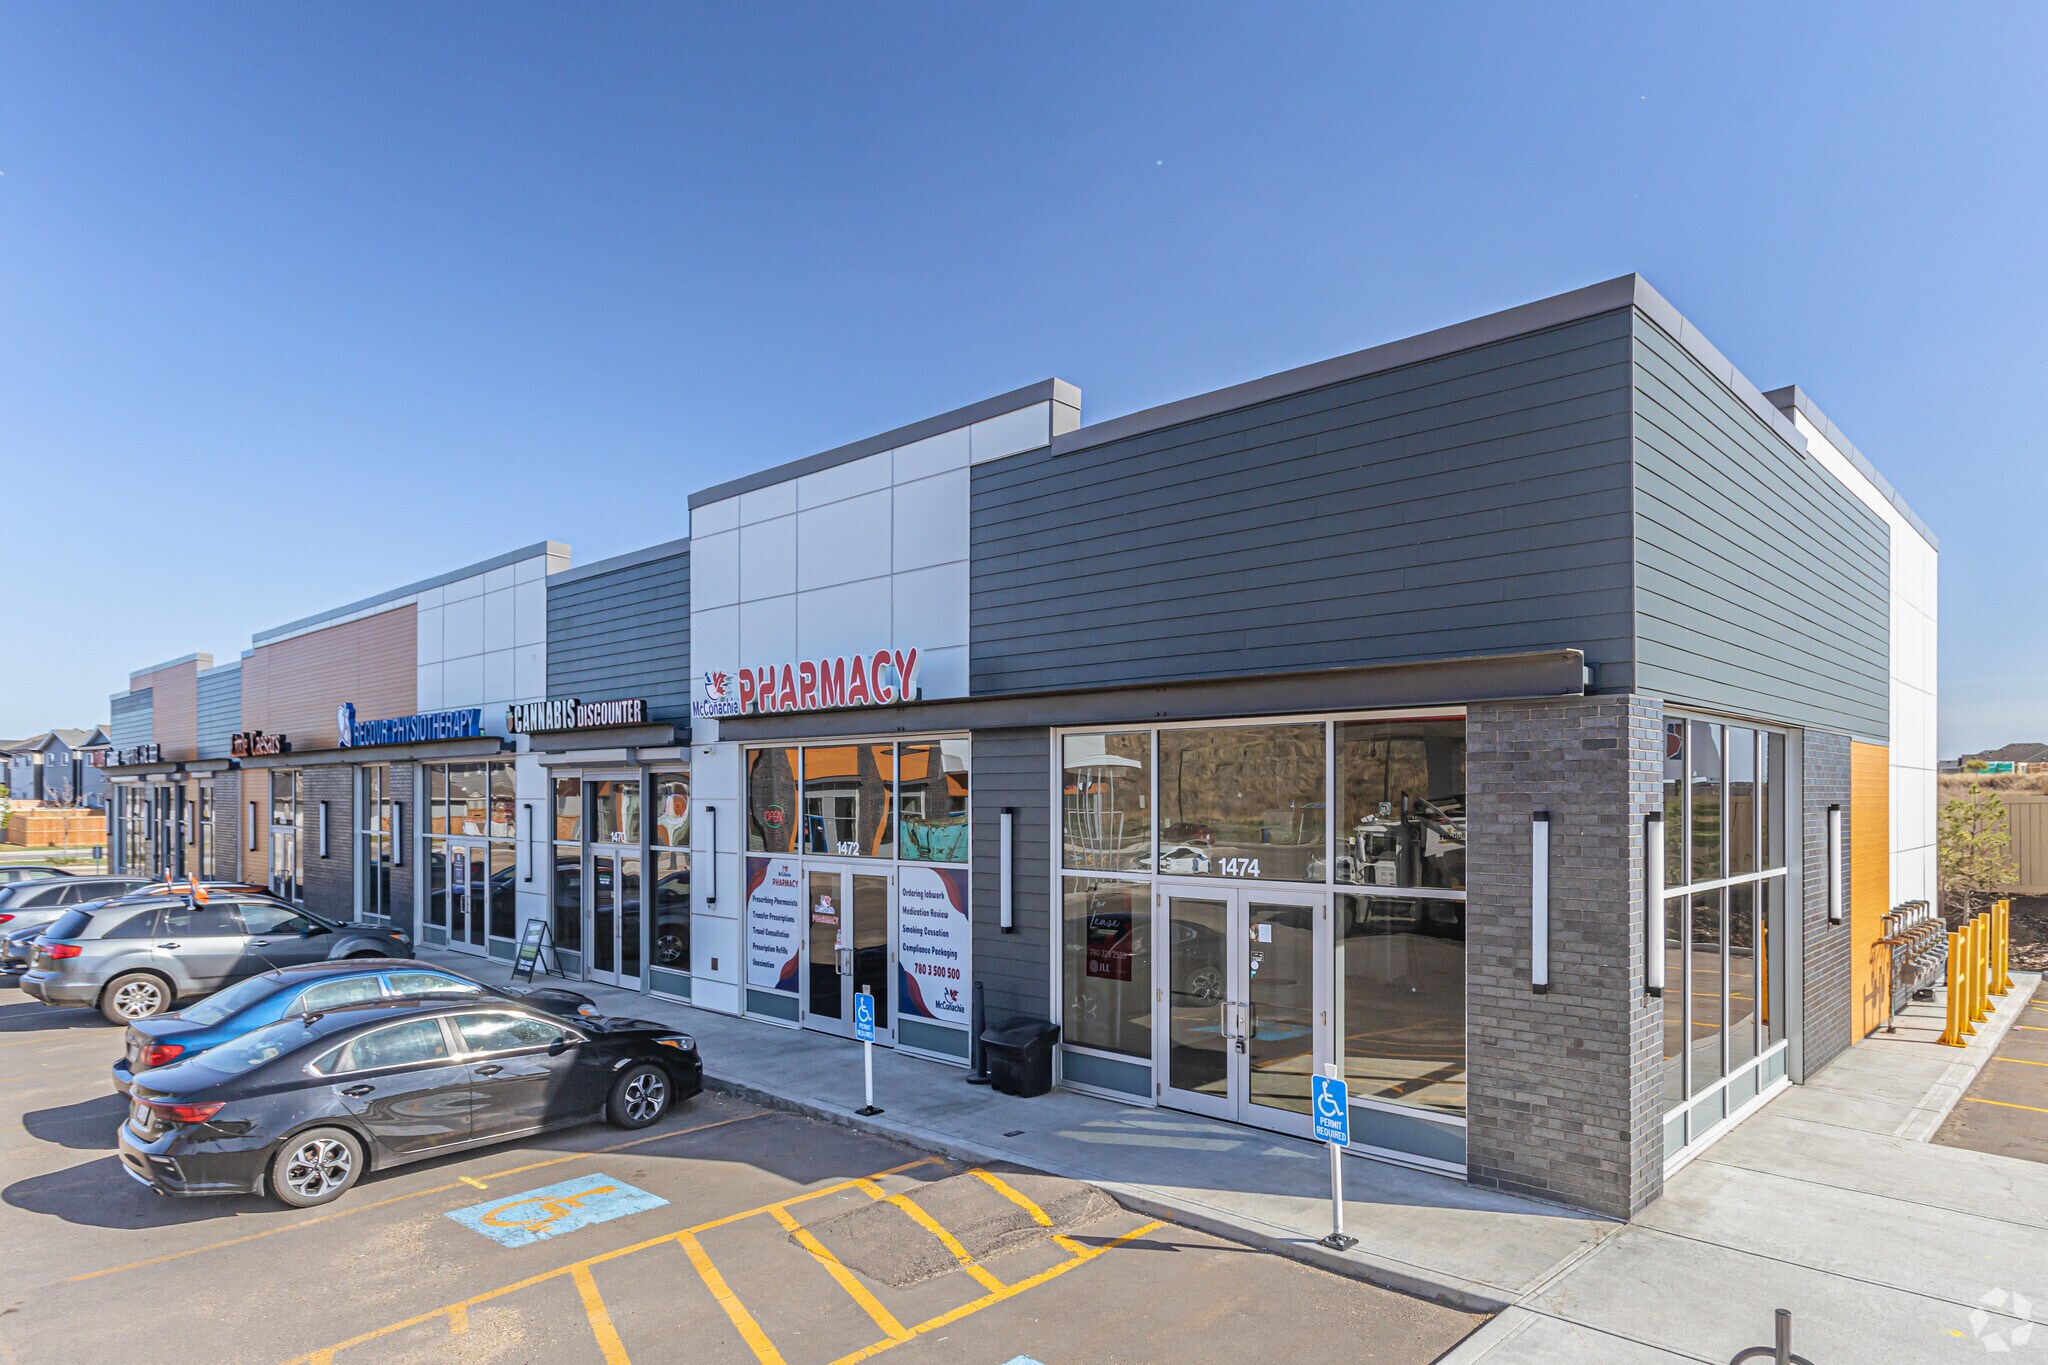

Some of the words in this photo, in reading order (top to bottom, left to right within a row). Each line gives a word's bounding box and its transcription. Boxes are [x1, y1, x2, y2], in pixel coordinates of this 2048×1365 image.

[693, 699, 739, 718] McConachie
[738, 647, 919, 716] PHARMACY
[514, 698, 576, 733] CANNABIS
[577, 699, 642, 728] DISCOUNTER
[354, 720, 388, 746] RECOVR
[392, 709, 474, 743] PHYSIOTHERAPY
[764, 810, 783, 823] OPEN
[837, 841, 860, 856] 1472
[1218, 857, 1261, 878] 1474
[772, 878, 799, 888] PHARMACY
[752, 894, 774, 906] Prescribing
[902, 887, 923, 900] Ordering
[1090, 892, 1106, 909] For
[752, 910, 769, 920] Transfer
[769, 912, 795, 923] Prescriptions
[902, 906, 930, 917] Medication
[930, 908, 949, 919] Review
[1089, 910, 1120, 929] Lease
[902, 924, 923, 938] Smoking
[924, 926, 950, 938] Cessation
[752, 942, 776, 953] Prescription
[902, 942, 931, 955] Compliance
[931, 946, 958, 961] Packaging
[914, 962, 927, 975] 780
[928, 964, 932, 976] 3
[933, 965, 946, 978] 500
[947, 967, 960, 980] 500
[936, 999, 965, 1014] McConachie
[1319, 1116, 1342, 1131] PERMIT
[1316, 1125, 1347, 1142] REQUIRED
